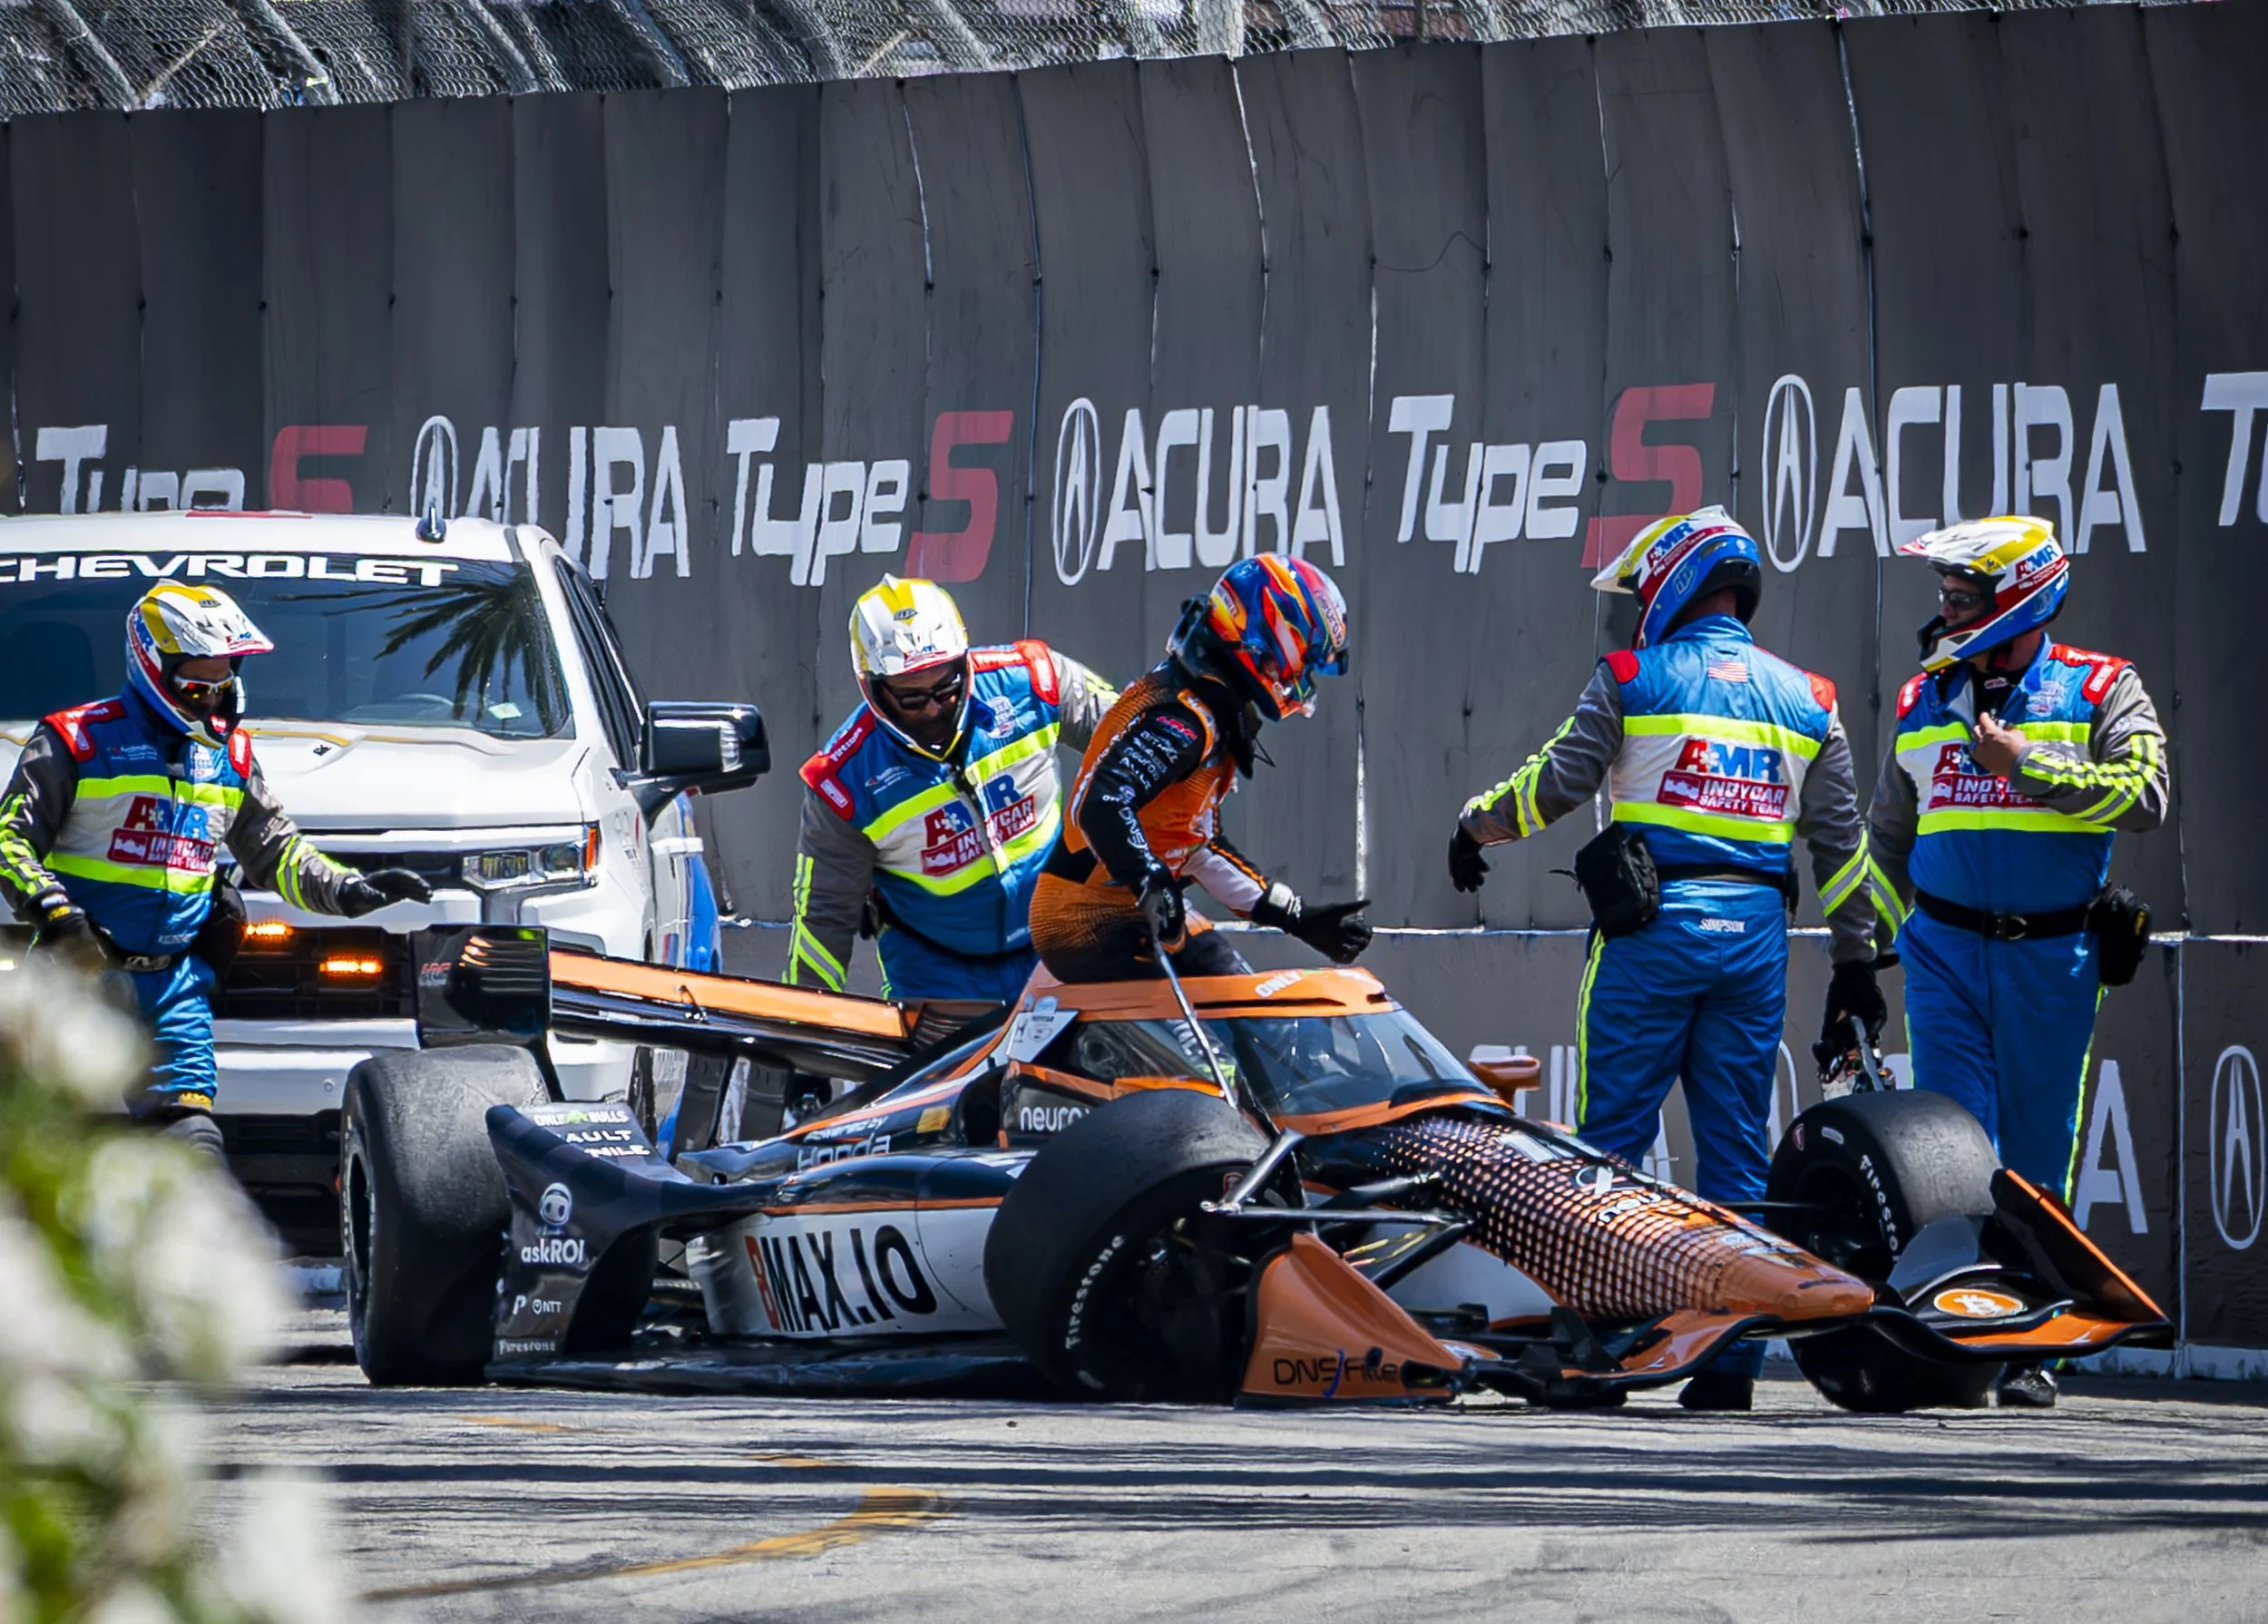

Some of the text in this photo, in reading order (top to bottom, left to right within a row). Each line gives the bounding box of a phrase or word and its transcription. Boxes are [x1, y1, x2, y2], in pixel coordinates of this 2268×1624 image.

[1097, 405, 1346, 571] ACURA
[1387, 383, 1715, 574] Type S
[1817, 381, 2147, 558] ACURA
[466, 426, 690, 578] ACURA
[727, 410, 1014, 586] Type S
[1647, 522, 1695, 569] AMR
[2015, 543, 2058, 581] AMR
[1674, 739, 1782, 783] AMR
[1699, 795, 1783, 817] SAFETY TEAM
[1702, 779, 1785, 805] INDYCAR
[1954, 792, 2038, 804] SAFETY TEA
[1955, 778, 2017, 794] INDY
[123, 796, 210, 842] AMR
[957, 798, 1033, 852] INYCAR
[1699, 918, 1745, 933] SIMPSON
[587, 1110, 631, 1124] BULLS
[1020, 1106, 1090, 1132] neuro
[797, 1132, 892, 1171] Honda
[1859, 1154, 1901, 1254] Firesto
[521, 1238, 585, 1264] askROI
[744, 1224, 938, 1332] BMAX.IO
[1064, 1234, 1125, 1350] Firestone
[498, 1340, 557, 1355] Firestone
